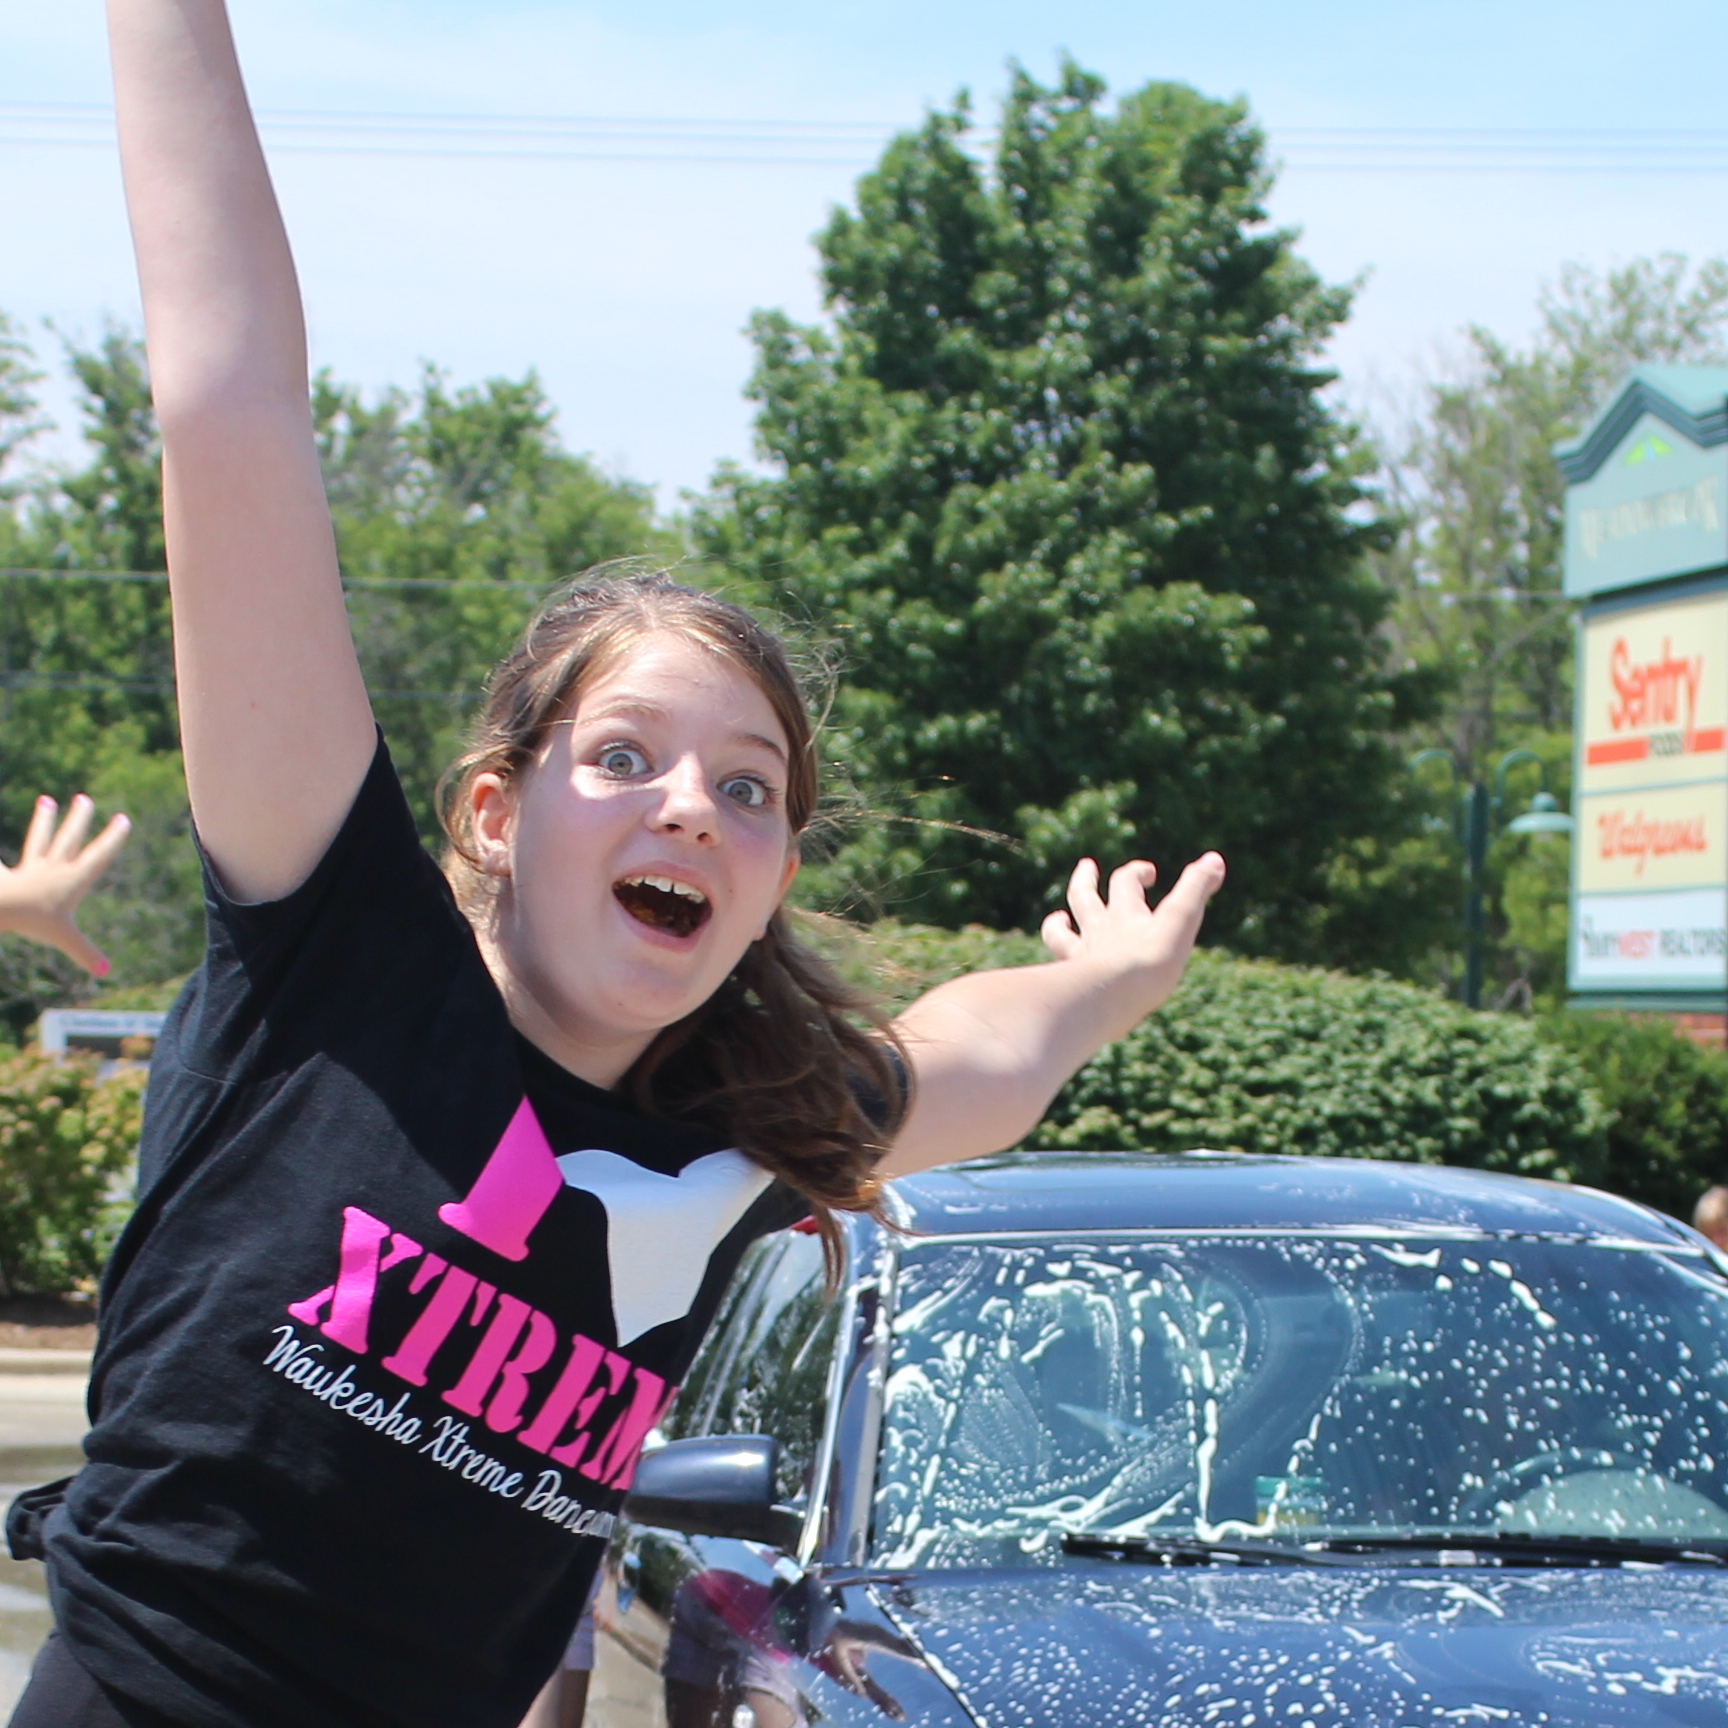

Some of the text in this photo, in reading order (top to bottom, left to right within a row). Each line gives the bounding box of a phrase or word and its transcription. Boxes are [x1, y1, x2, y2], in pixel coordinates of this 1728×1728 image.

[1608, 635, 1704, 742] Sentry
[263, 1325, 421, 1445] Waukesha
[418, 1415, 525, 1499] Xtreme
